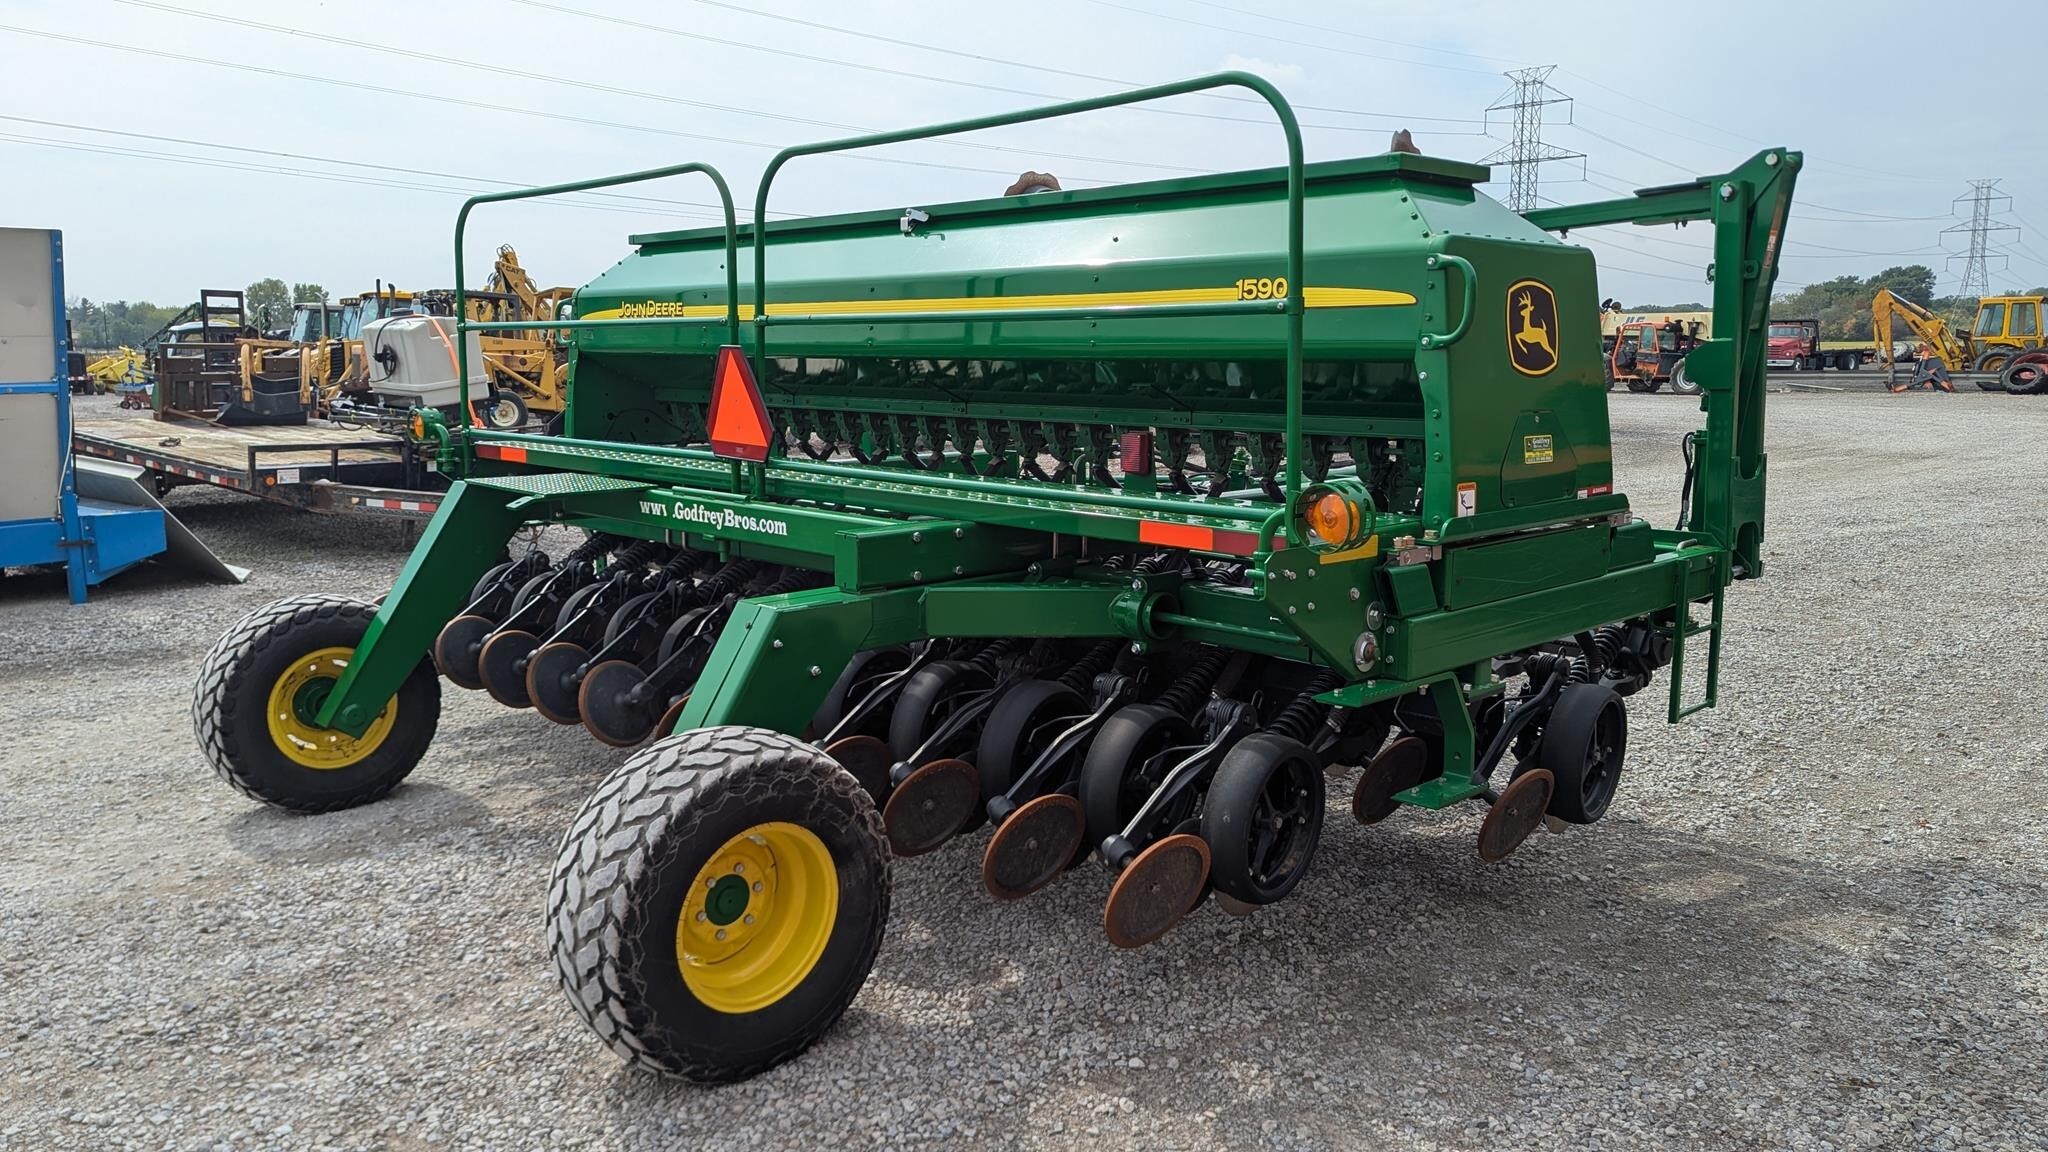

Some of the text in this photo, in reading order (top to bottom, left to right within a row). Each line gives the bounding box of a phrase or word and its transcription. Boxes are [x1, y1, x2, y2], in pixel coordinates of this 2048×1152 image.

[1235, 277, 1289, 300] 1590
[617, 300, 684, 318] JOHN DEERE
